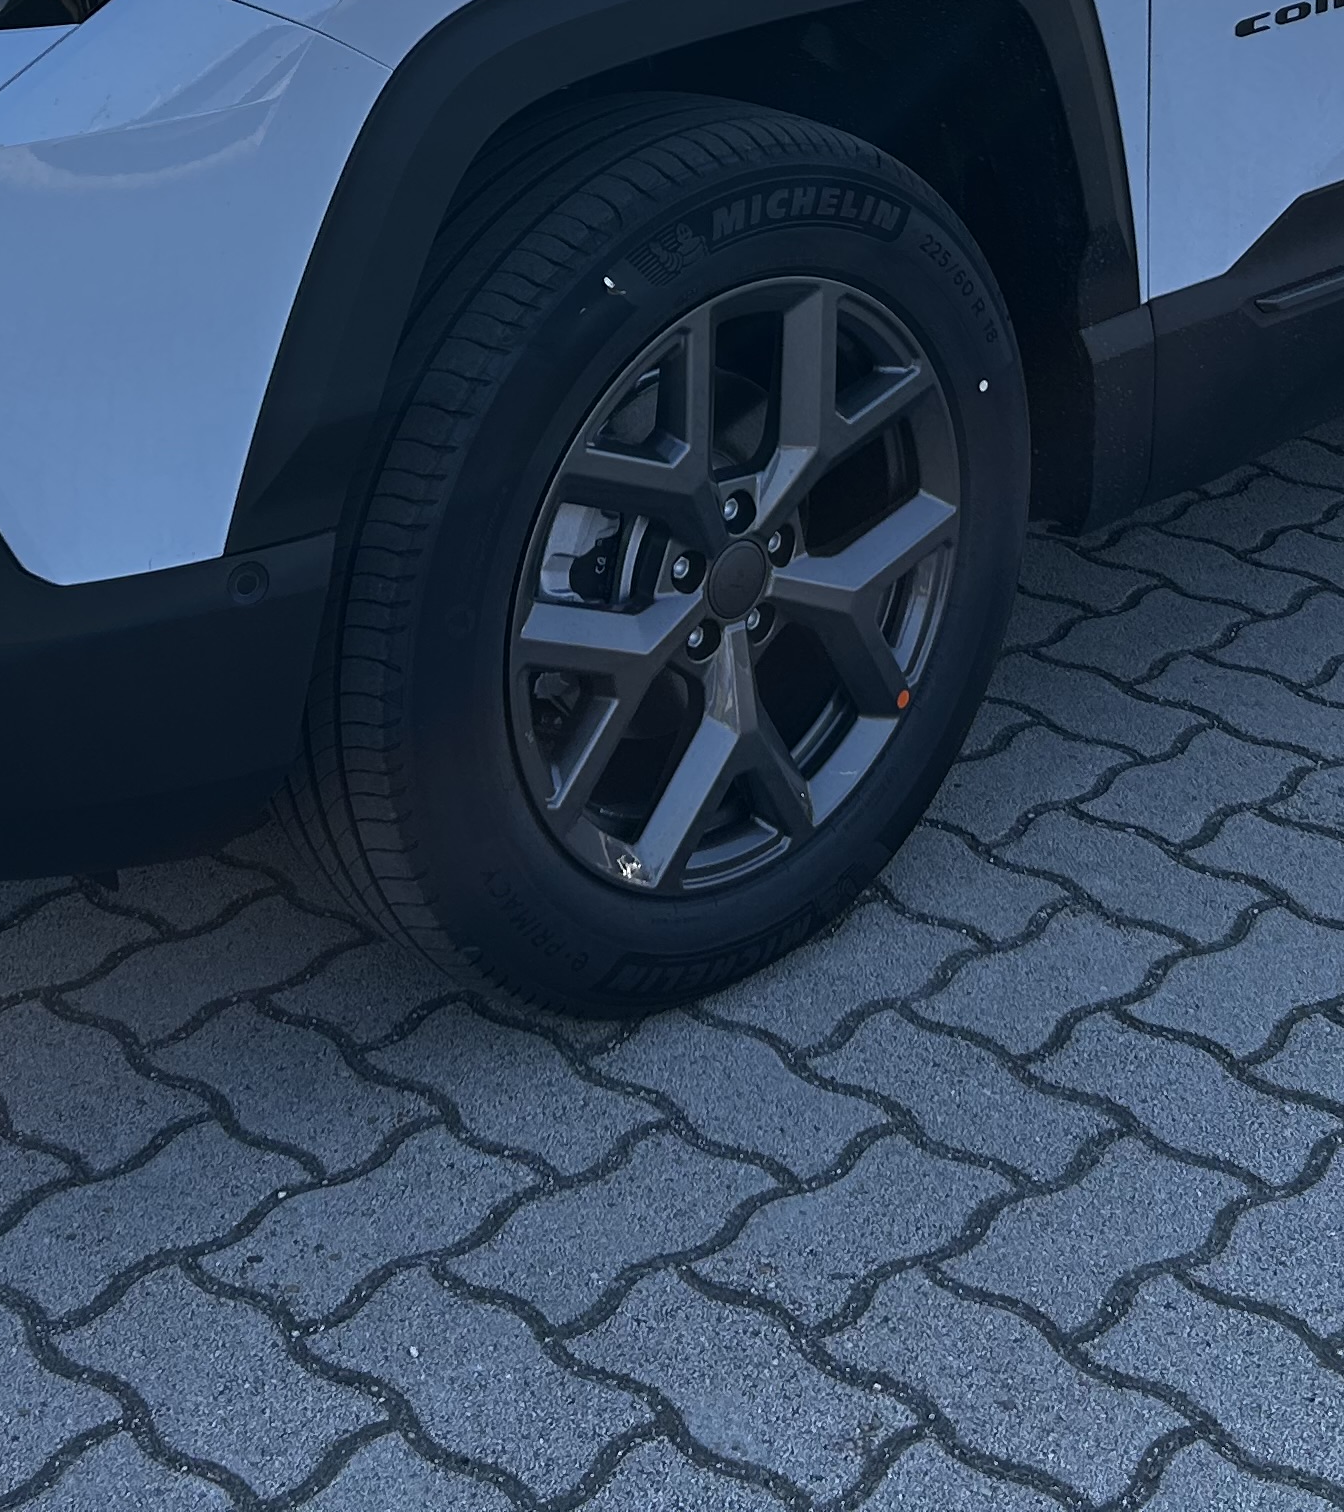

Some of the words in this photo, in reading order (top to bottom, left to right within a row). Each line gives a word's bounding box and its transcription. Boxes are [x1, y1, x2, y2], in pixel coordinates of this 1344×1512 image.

[711, 184, 901, 241] MICHELIN
[918, 233, 974, 296] 225/60
[971, 298, 986, 319] R
[983, 321, 1000, 344] 18
